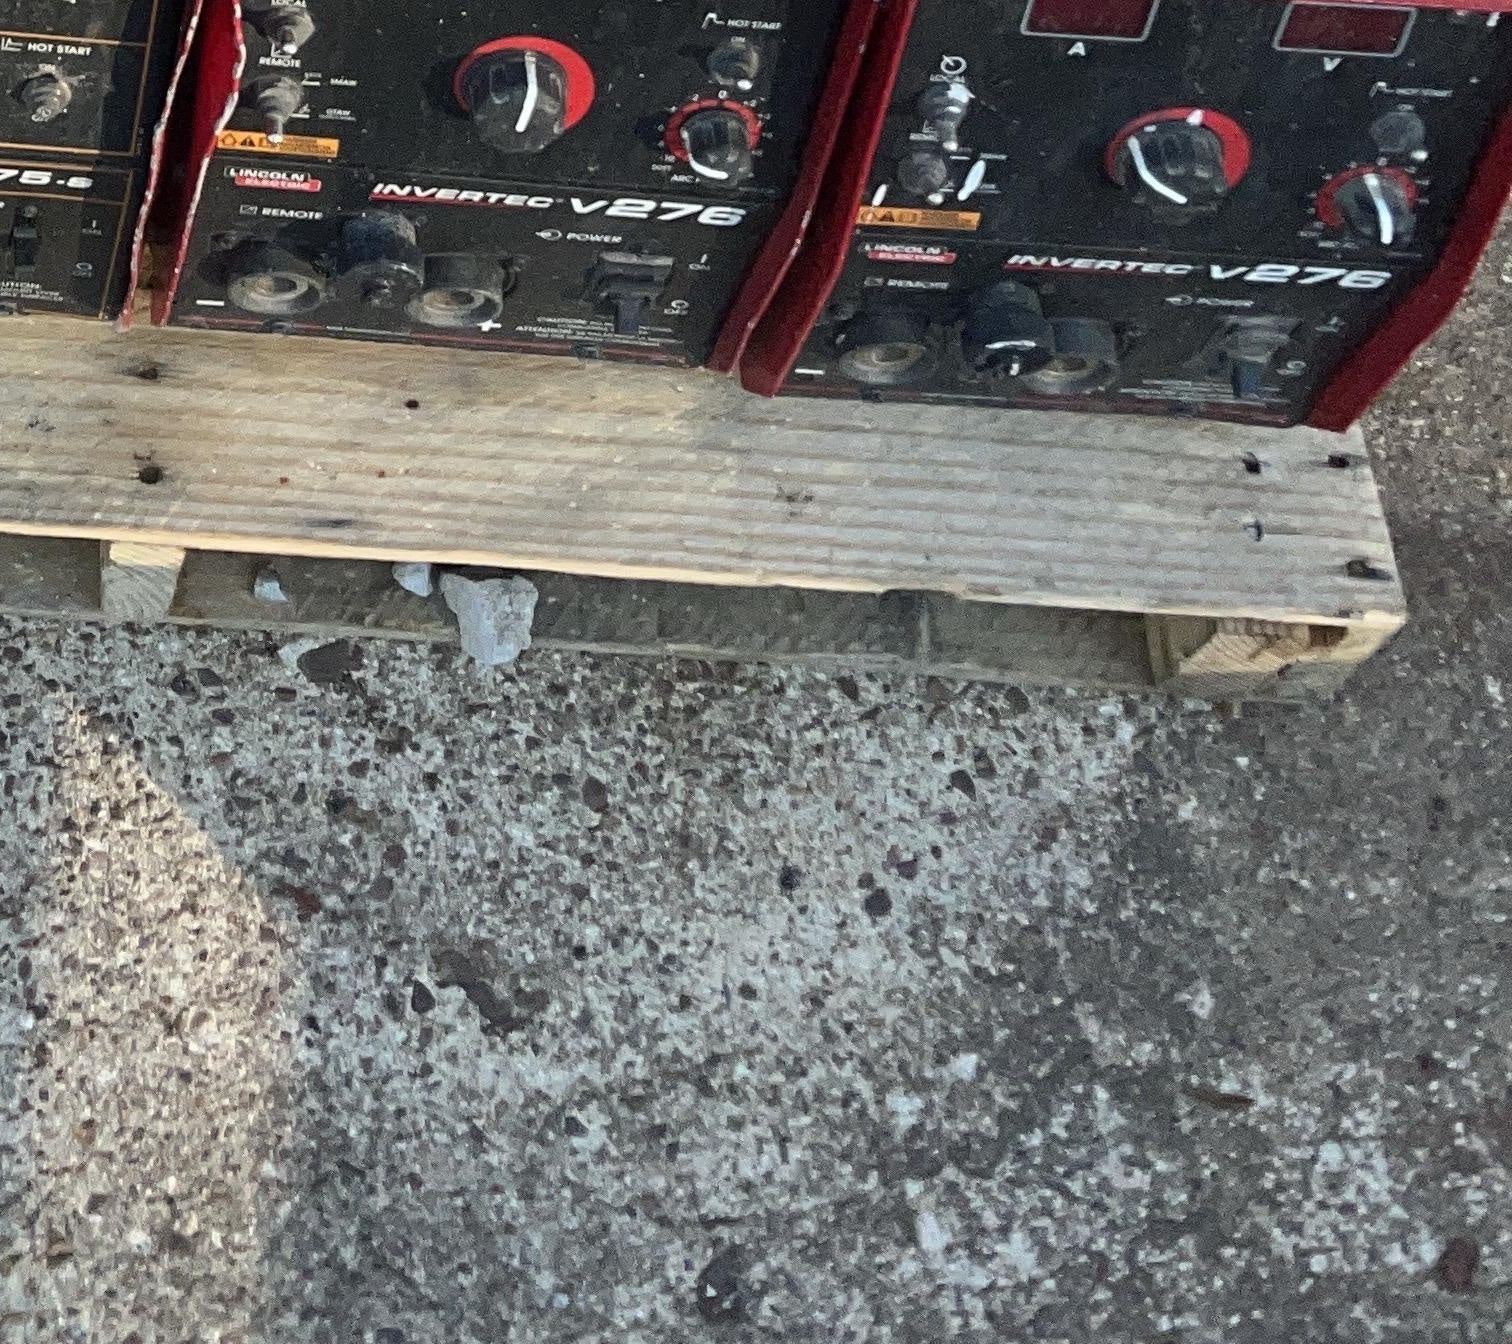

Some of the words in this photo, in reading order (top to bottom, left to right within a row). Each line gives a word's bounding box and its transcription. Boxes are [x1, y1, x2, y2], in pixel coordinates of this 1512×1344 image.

[727, 18, 750, 29] HOT
[751, 20, 783, 30] START
[27, 42, 56, 54] HOT
[57, 44, 93, 57] START
[1066, 41, 1087, 57] A
[258, 56, 302, 69] REMOTE
[1322, 56, 1344, 72] V
[229, 166, 305, 181] LINCOLN
[371, 182, 554, 209] INVERTEC
[570, 196, 748, 228] V276
[261, 206, 325, 220] REMOTE
[565, 231, 623, 244] POWER
[864, 243, 942, 255] LINCOLN
[1006, 254, 1193, 275] INVERTEC
[1209, 263, 1392, 289] V276
